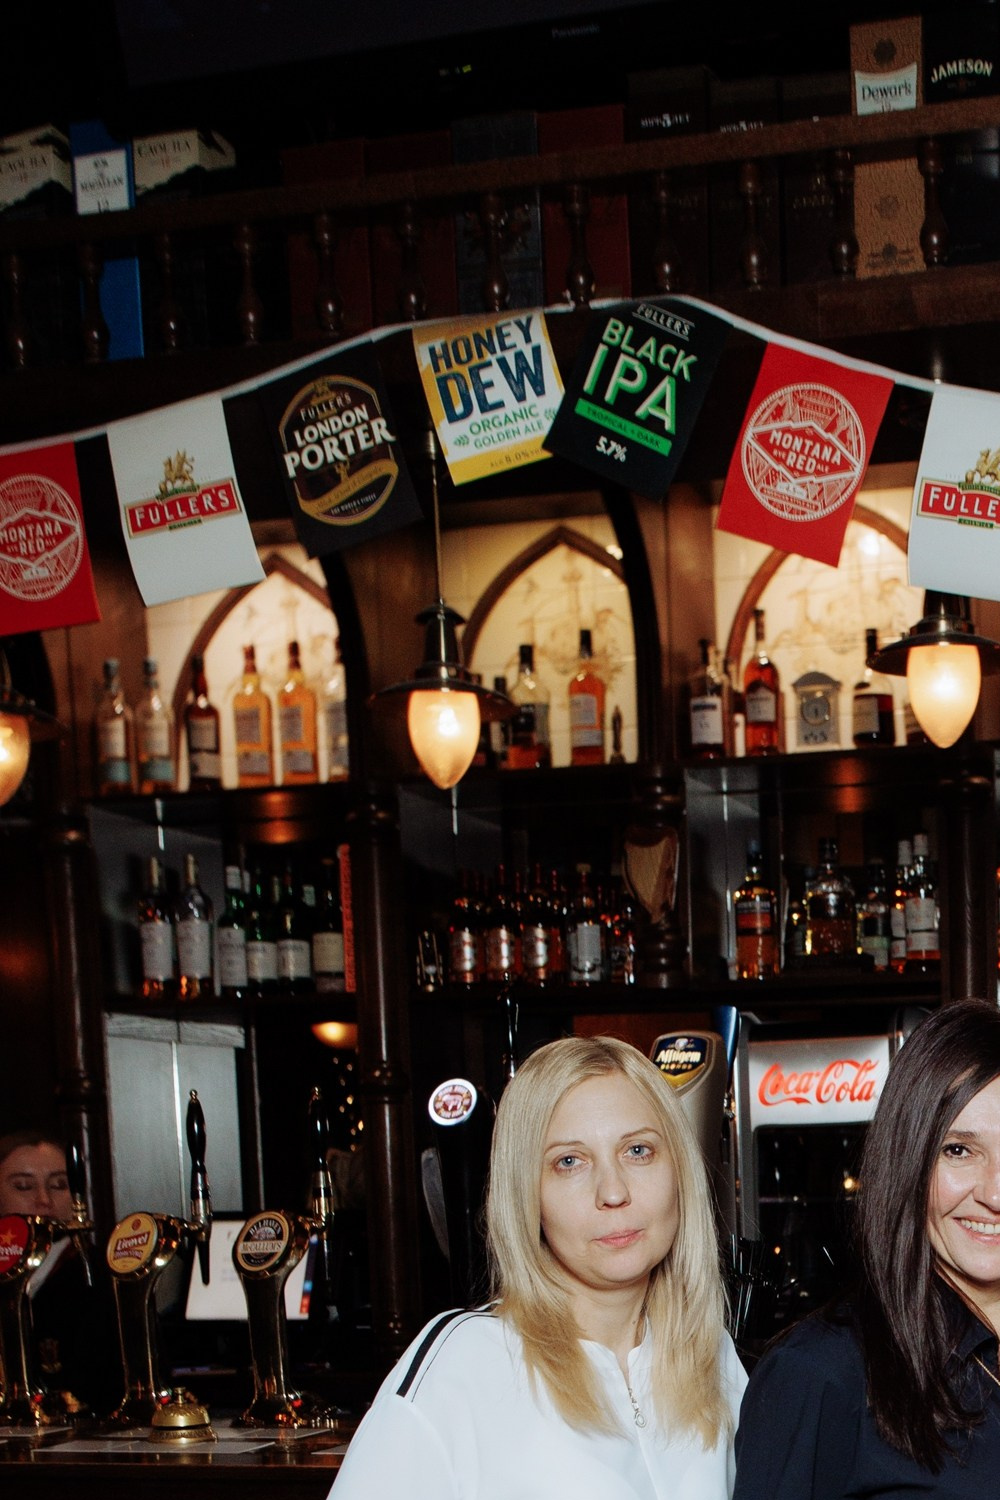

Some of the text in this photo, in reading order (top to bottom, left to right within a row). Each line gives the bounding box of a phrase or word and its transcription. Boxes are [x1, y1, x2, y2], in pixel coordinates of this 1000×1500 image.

[931, 57, 993, 83] JAMESON
[428, 314, 533, 374] HONEY
[602, 317, 698, 382] BLACK
[435, 344, 546, 424] DEW
[583, 343, 677, 435] IPA
[293, 404, 370, 447] LONDON
[469, 404, 539, 436] ORGANIC
[474, 421, 544, 449] GOLDEN ALE
[283, 417, 396, 478] PORTER
[769, 430, 841, 465] MONTANA
[773, 448, 829, 474] RYE RED ALE
[134, 487, 230, 528] FULLER'S
[1, 520, 63, 546] MONTANA
[20, 540, 45, 556] RED
[656, 1049, 701, 1064] Affligem
[758, 1057, 879, 1107] Coca-Cola
